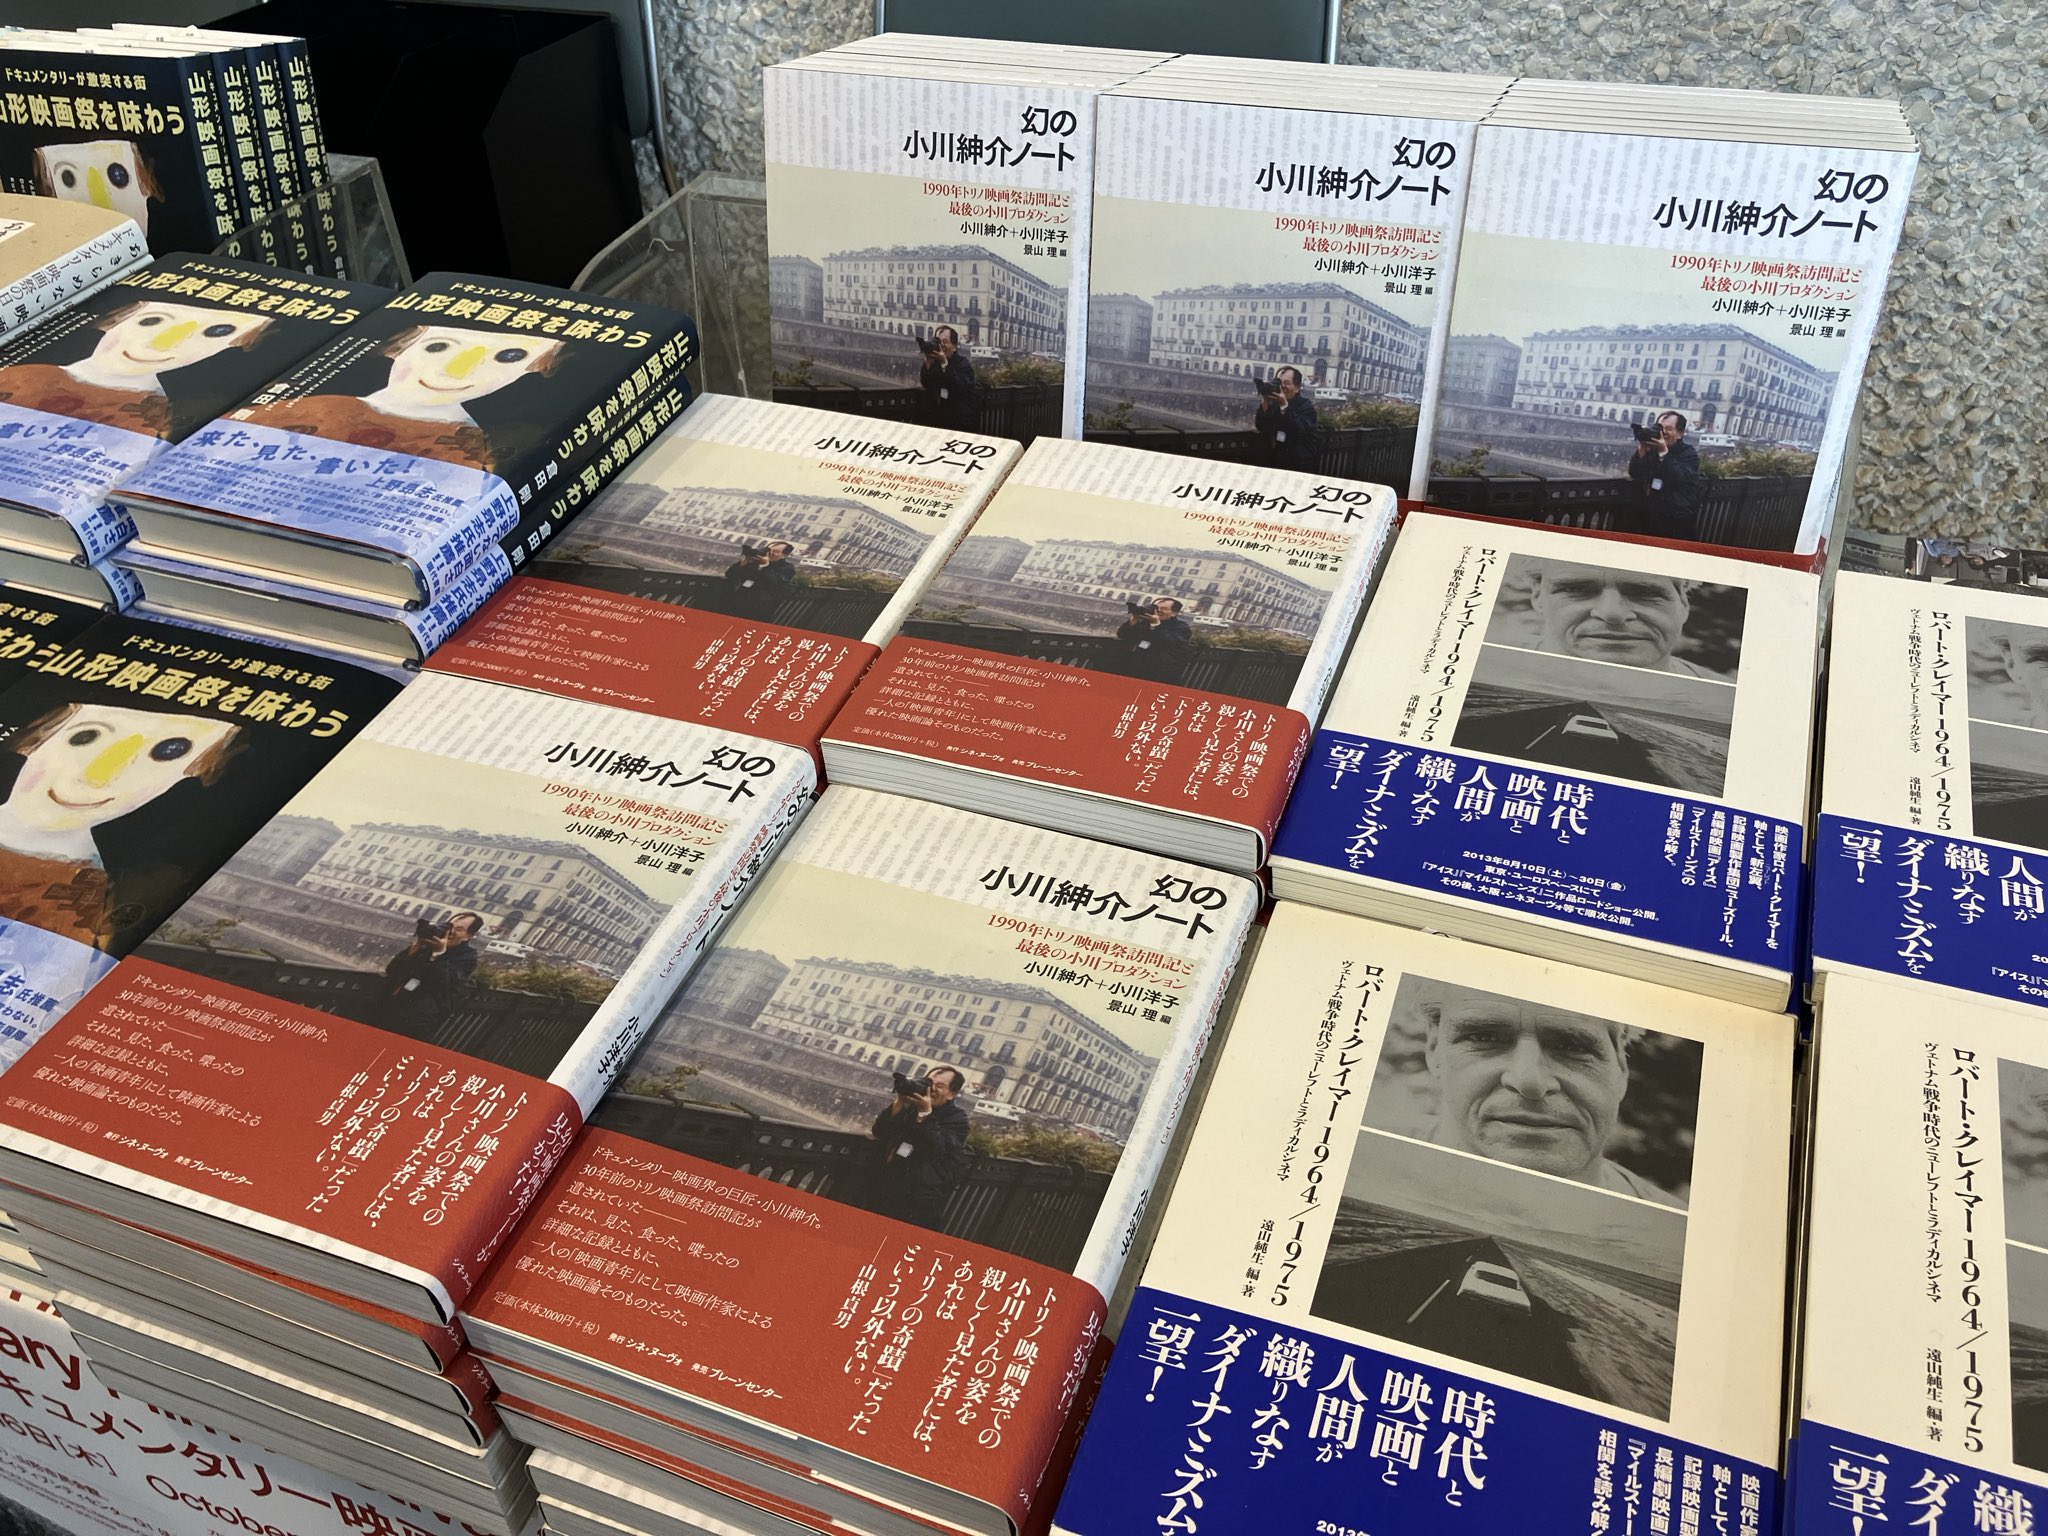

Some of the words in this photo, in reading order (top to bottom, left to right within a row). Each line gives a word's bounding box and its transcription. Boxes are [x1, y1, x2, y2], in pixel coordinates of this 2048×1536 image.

[1021, 106, 1077, 137] 幻の
[903, 130, 1075, 172] 小川紳介ノート
[1392, 137, 1455, 170] 幻の
[923, 182, 1071, 208] 1990年トリノ映画祭訪問記と
[949, 201, 1070, 224] 最後の小川プロダクション
[1255, 162, 1450, 206] 小川紳介ノート
[1814, 168, 1889, 204] 幻の
[960, 222, 1069, 243] 小川紳介＋小川洋子
[1274, 217, 1442, 244] 1990年トリノ映画祭訪問記と
[1653, 196, 1878, 243] 小川紳介ノート
[1303, 237, 1439, 261] 最後の小川プロダクション
[1314, 258, 1436, 281] 小川紳介＋小川洋子
[1671, 255, 1862, 283] 1990年トリノ映画祭訪問記と
[119, 269, 361, 325] 山形映画祭を味わう
[1701, 275, 1857, 301] 最後の小川プロダクション
[1712, 298, 1852, 323] 小川紳介＋小川洋子
[385, 291, 652, 348] 山形映画祭を味わう
[814, 436, 984, 474] 小川紳介ノート
[940, 439, 997, 459] 幻の
[837, 474, 961, 501] 最後の小川プロダクション
[1172, 483, 1364, 523] 小川紳介ノート
[1310, 484, 1372, 505] 幻の
[1183, 511, 1352, 544] 1990年トリノ映画祭訪問記と
[1208, 525, 1348, 553] 最後の小川プロダクション
[1216, 538, 1343, 563] 小川紳介＋小川洋子
[122, 634, 335, 692] ドキュメンタリーが激突する街
[38, 648, 350, 738] 山形映画祭を味わう
[1187, 701, 1211, 733] あれは
[544, 742, 755, 803] 小川紳介ノート
[703, 745, 776, 778] 幻の
[1213, 708, 1257, 786] 小川さんの姿を
[1232, 714, 1277, 798] トリノ映画祭での
[1322, 739, 1370, 790] 一望！
[541, 783, 728, 834] 1990年トリノ映画祭訪問記と
[1344, 749, 1413, 869] ダイナミズムを
[1411, 754, 1456, 826] 織りなす
[1454, 764, 1498, 822] 人間が
[1501, 772, 1548, 834] 映画と
[1549, 781, 1594, 844] 時代と
[562, 803, 717, 846] 最後の小川プロダクション
[565, 821, 705, 863] 小川紳介＋小川洋子
[1840, 825, 1884, 884] 一望！
[979, 865, 1214, 940] 小川紳介ノート
[1149, 874, 1227, 911] 幻の
[1895, 836, 1937, 975] ダイナミズムを
[1944, 843, 1990, 925] 織りなす
[1998, 856, 2046, 921] 人間が
[987, 914, 1195, 975] 1990年トリノ映画祭訪問記と
[1015, 938, 1188, 990] 最後の小川プロダクション
[1024, 960, 1180, 1009] 小川紳介＋小川洋子
[115, 989, 275, 1043] 30年前のトリノ映画祭訪問記が
[66, 1034, 170, 1077] 詳細な記録とともに、
[1277, 959, 1354, 1182] ヴェトナム戦争時代のニューレフトとラディカルシネマ
[33, 1065, 184, 1126] 優れた映画論そのものだった。
[315, 1055, 415, 1173] という以外ない。
[413, 1069, 457, 1119] あれは
[306, 1059, 443, 1214] 「トリノの奇蹟」だった
[364, 1074, 486, 1228] 親しく見た者には、
[408, 1083, 506, 1207] 小川さんの姿を
[423, 1091, 528, 1227] トリノ映画祭での
[579, 1163, 762, 1229] 30年前のトリノ映画祭訪問記が
[593, 1145, 823, 1230] ドキュメンタリー映画界の巨匠・小川紳介。
[1922, 1042, 1944, 1304] ヴェトナム戦争時代のニューレフトとラディカルシネマ
[541, 1217, 660, 1268] 詳細な記録とともに、
[556, 1200, 740, 1268] それは、見た、食った、喋ったの
[1251, 1218, 1275, 1266] 遠山純生
[514, 1254, 690, 1328] 優れた映画論そのものだった。
[531, 1238, 773, 1329] 一人の「映画青年」にして映画作家による
[936, 1260, 973, 1321] あれは
[844, 1245, 921, 1385] という以外ない。
[848, 1250, 954, 1435] 「トリノの奇蹟」だった
[625, 1336, 683, 1367] シネ・ヌーヴォ
[708, 1367, 783, 1400] ブレーンセンター
[913, 1266, 1007, 1453] 親しく見た者には、
[955, 1278, 1031, 1425] 小川さんの姿を
[979, 1287, 1057, 1449] トリノ映画祭での
[1138, 1307, 1201, 1403] 一望！
[1926, 1347, 1943, 1404] 遠山純生
[1157, 1324, 1258, 1536] ダイナミズム
[1248, 1333, 1315, 1470] 織りなす
[1308, 1354, 1369, 1464] 人間が
[1370, 1369, 1434, 1486] 映画と
[1433, 1386, 1497, 1507] 時代と
